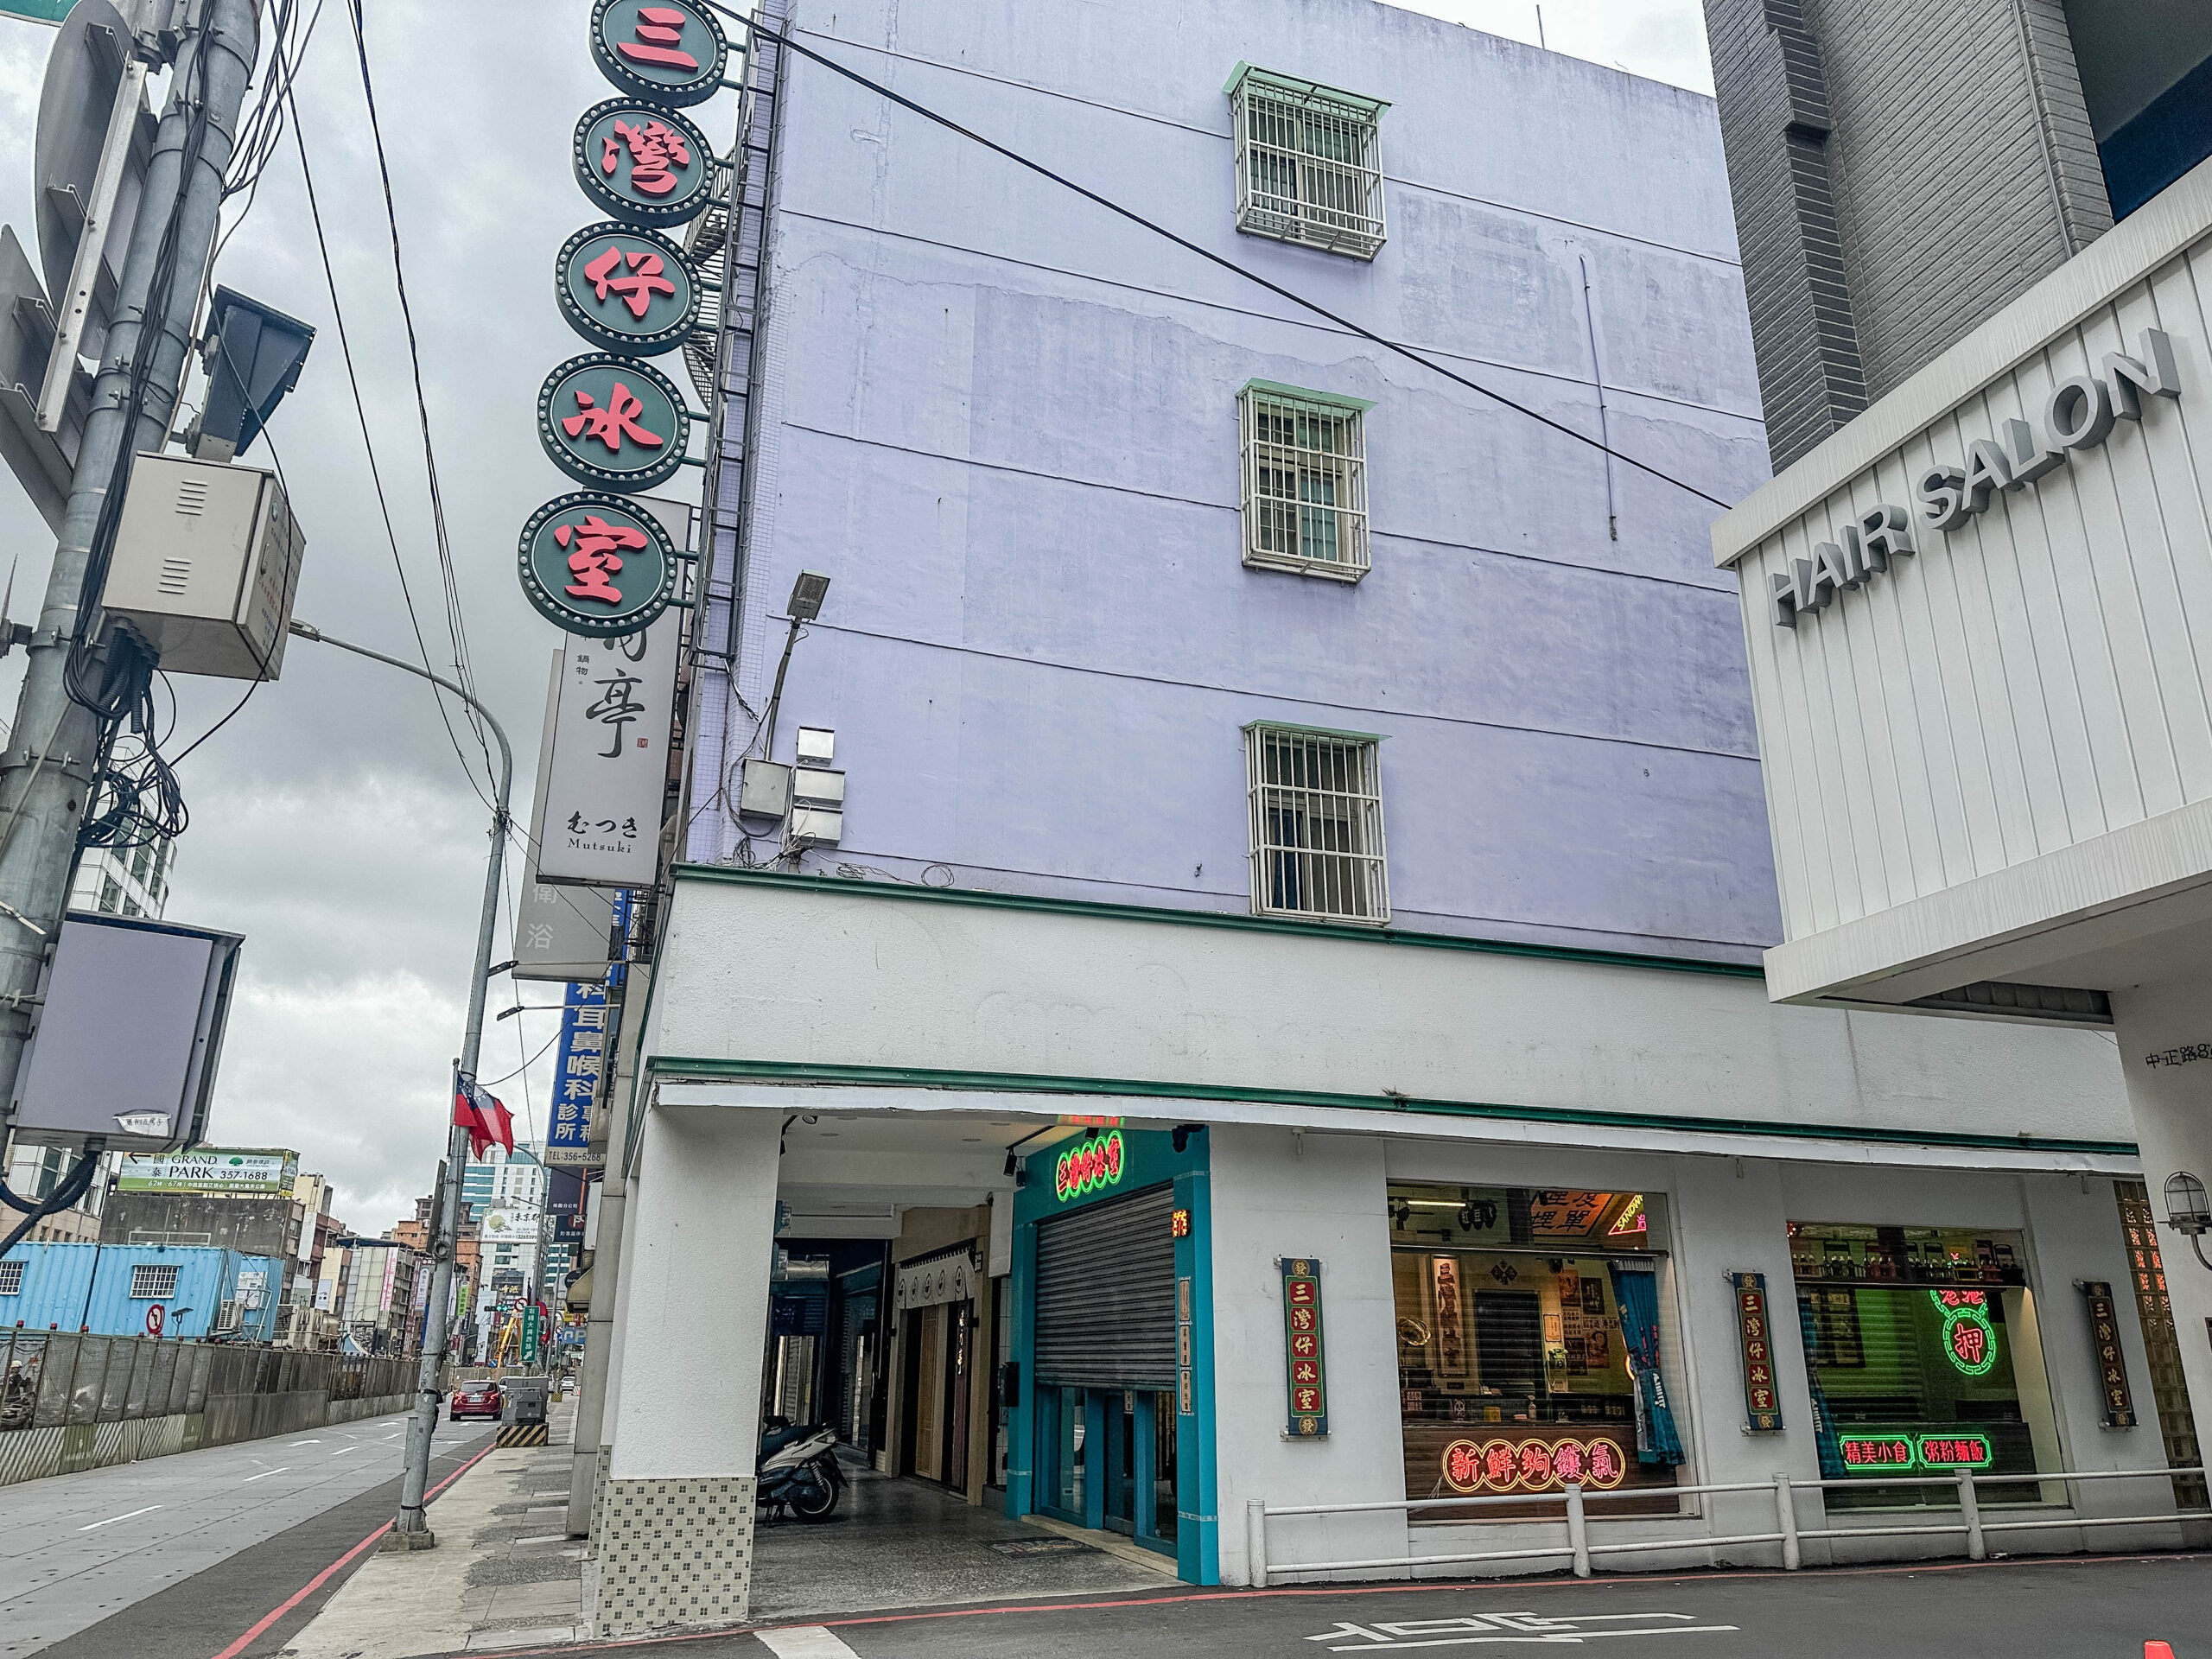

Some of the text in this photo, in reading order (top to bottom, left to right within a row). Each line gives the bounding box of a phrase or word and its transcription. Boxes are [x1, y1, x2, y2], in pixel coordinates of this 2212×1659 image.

[554, 7, 699, 607] 三灣仔冰室
[1768, 327, 2182, 628] HAIR SALON
[567, 810, 639, 839] むつき
[567, 837, 632, 855] Mutsuki
[2145, 1043, 2212, 1070] 中正路8
[555, 1103, 579, 1141] 診所
[171, 1154, 218, 1165] GRAND
[548, 1150, 601, 1162] TEL:356-5268
[168, 1166, 214, 1179] PARK
[219, 1171, 268, 1180] 357-1688
[1292, 1283, 1317, 1411] 三灣仔冰室
[1743, 1293, 1770, 1410] 三灣仔冰室
[1954, 1322, 1984, 1364] 押
[2094, 1301, 2125, 1408] 三灣仔冰室
[1844, 1440, 1909, 1465] 精美小食
[1924, 1440, 1985, 1463] 粥粉麵飯
